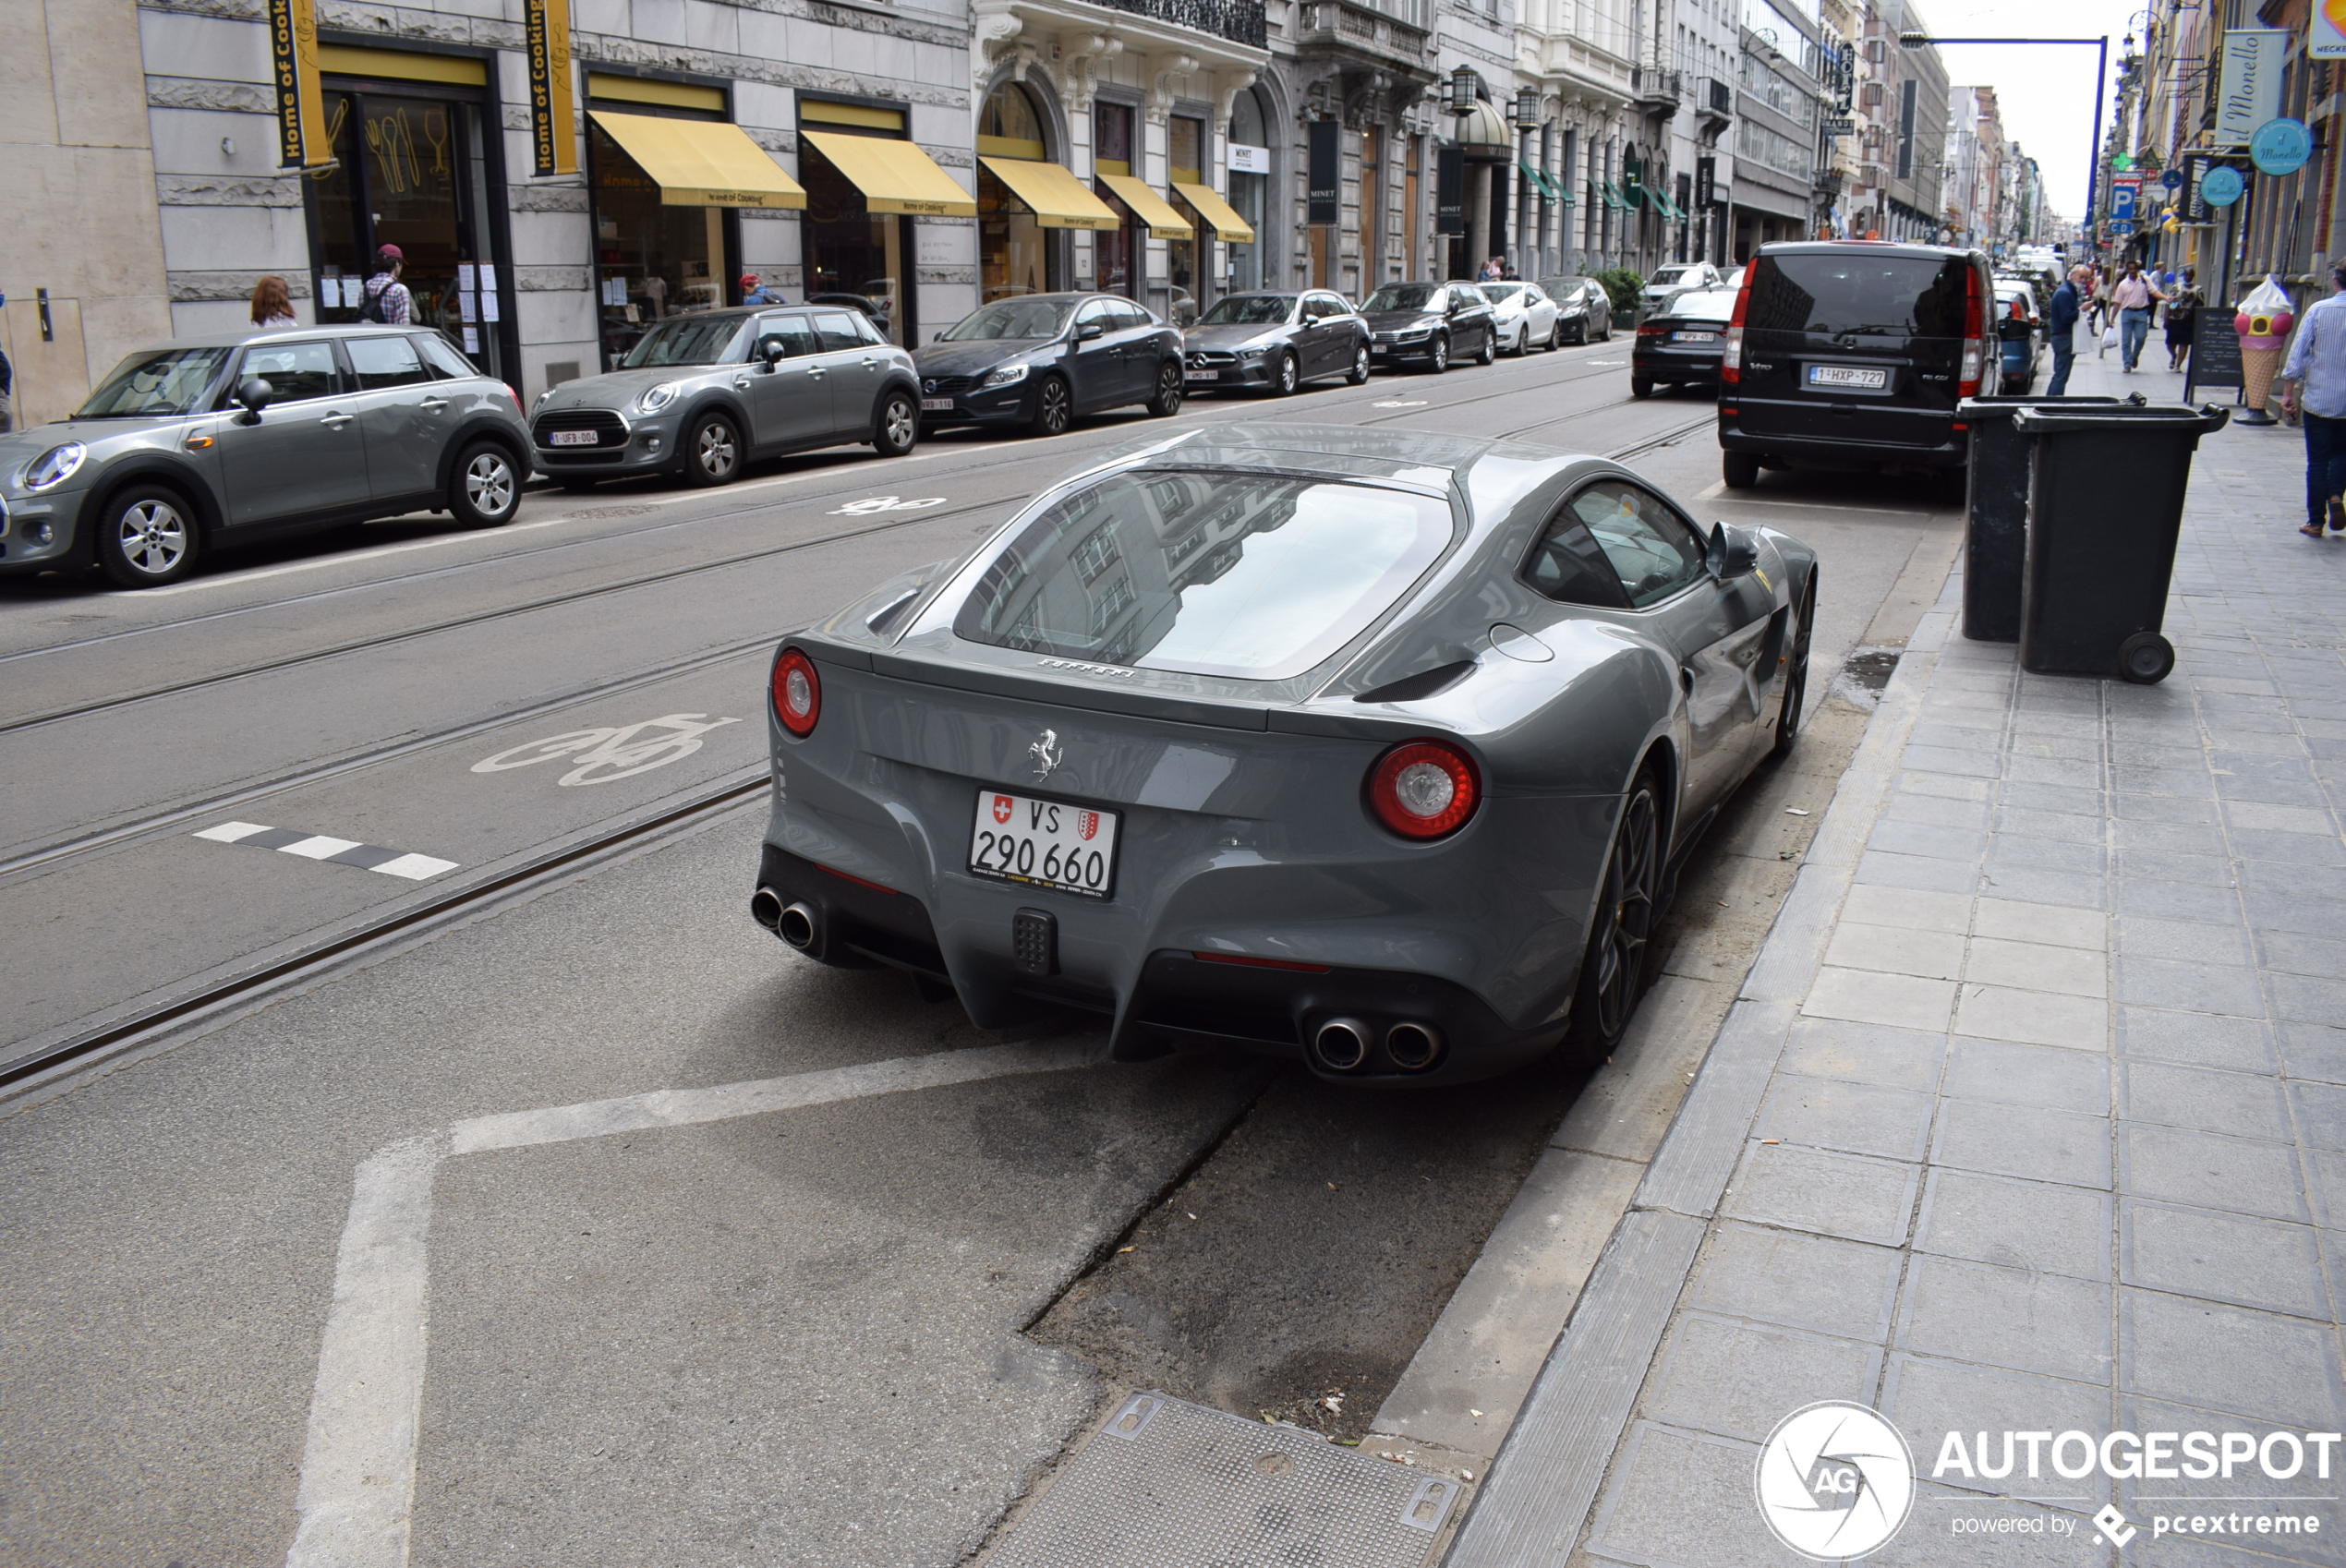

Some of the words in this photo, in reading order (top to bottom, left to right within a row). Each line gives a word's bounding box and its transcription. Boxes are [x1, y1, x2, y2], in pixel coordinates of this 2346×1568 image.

[528, 0, 546, 80] Cooking
[278, 62, 293, 87] of
[2225, 37, 2258, 119] Monello
[533, 85, 548, 107] of
[284, 93, 300, 157] Home
[2223, 127, 2250, 141] il
[538, 112, 551, 168] Home
[2278, 132, 2286, 146] il
[1236, 149, 1252, 159] MINET
[2260, 146, 2302, 160] Monello
[737, 193, 764, 206] Cooking
[925, 203, 944, 213] Cooking
[2112, 190, 2133, 214] P
[2189, 182, 2199, 216] FITNESS
[1818, 368, 1884, 384] 1-HXP-727
[555, 432, 596, 443] 1-UFB-004
[1031, 801, 1060, 833] VS
